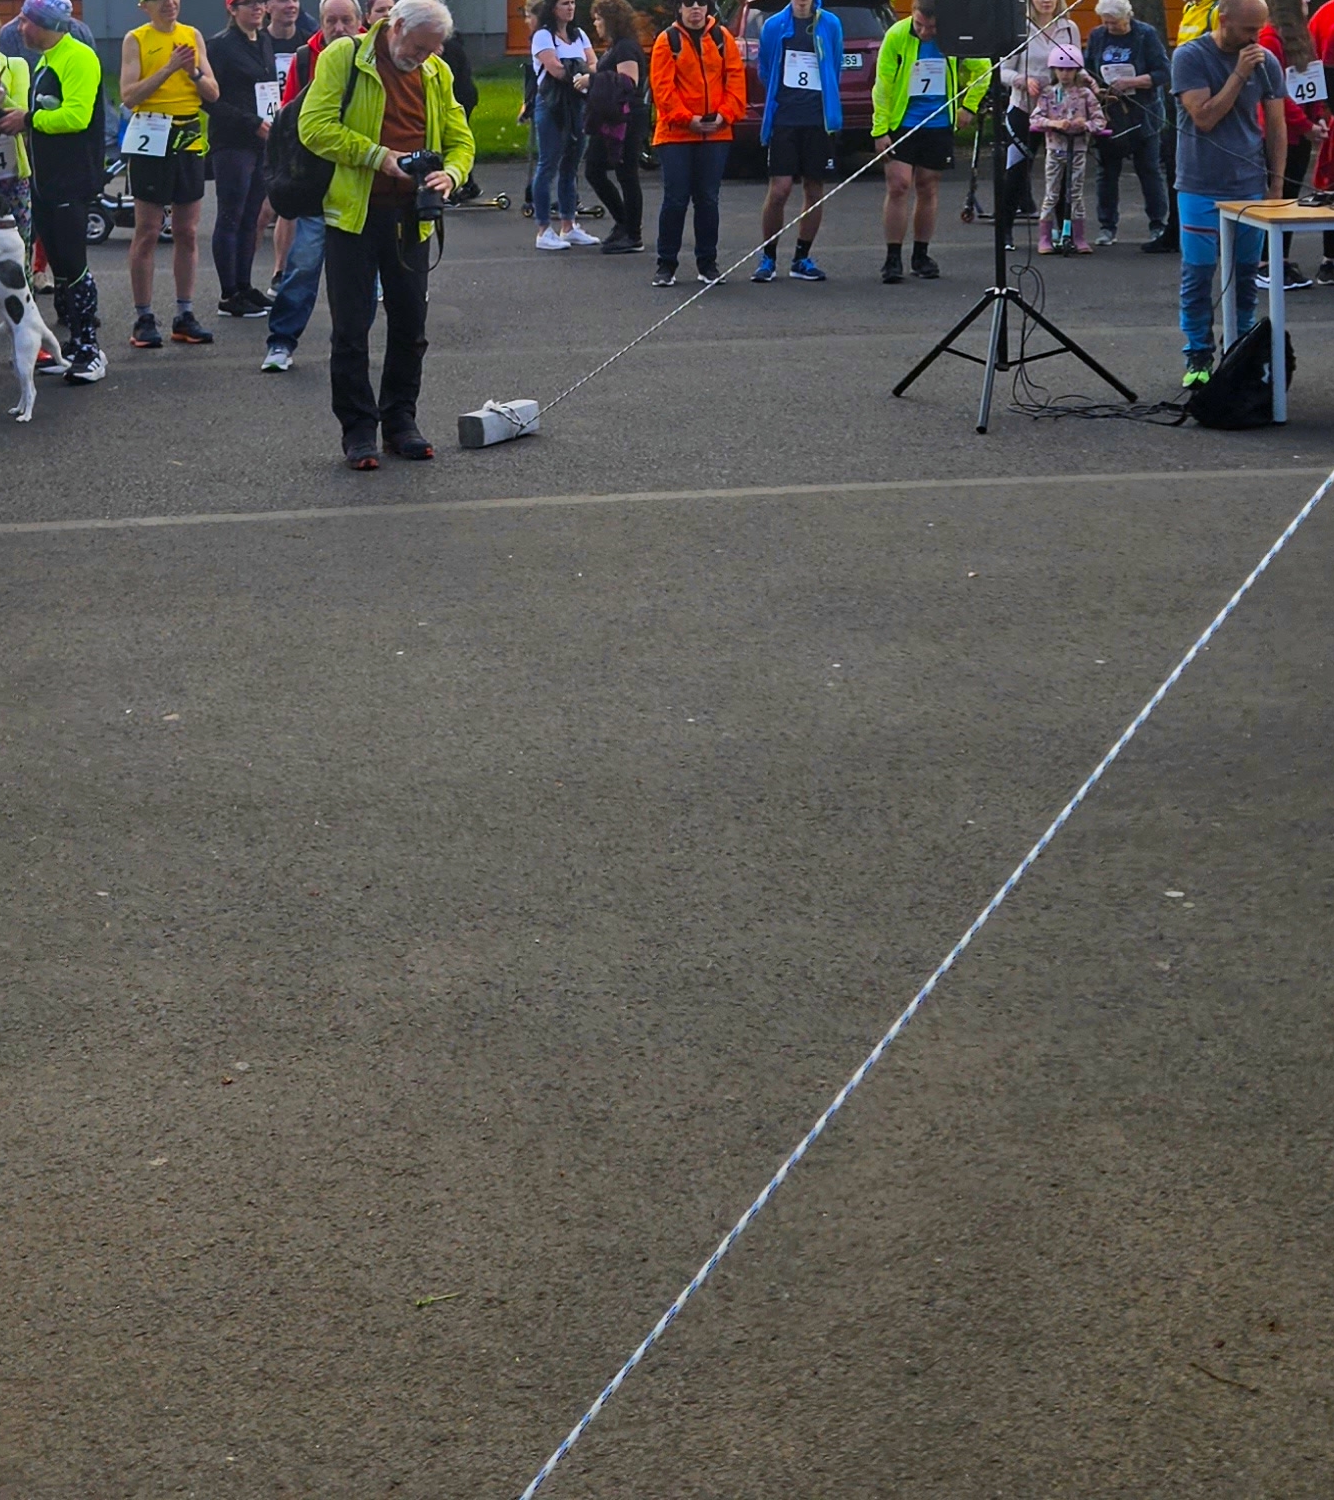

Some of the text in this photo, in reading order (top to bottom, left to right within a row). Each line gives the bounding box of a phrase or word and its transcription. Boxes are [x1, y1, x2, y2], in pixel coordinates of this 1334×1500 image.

[798, 71, 809, 86] 8
[921, 78, 931, 93] 7
[1295, 81, 1317, 100] 49
[137, 135, 150, 151] 2
